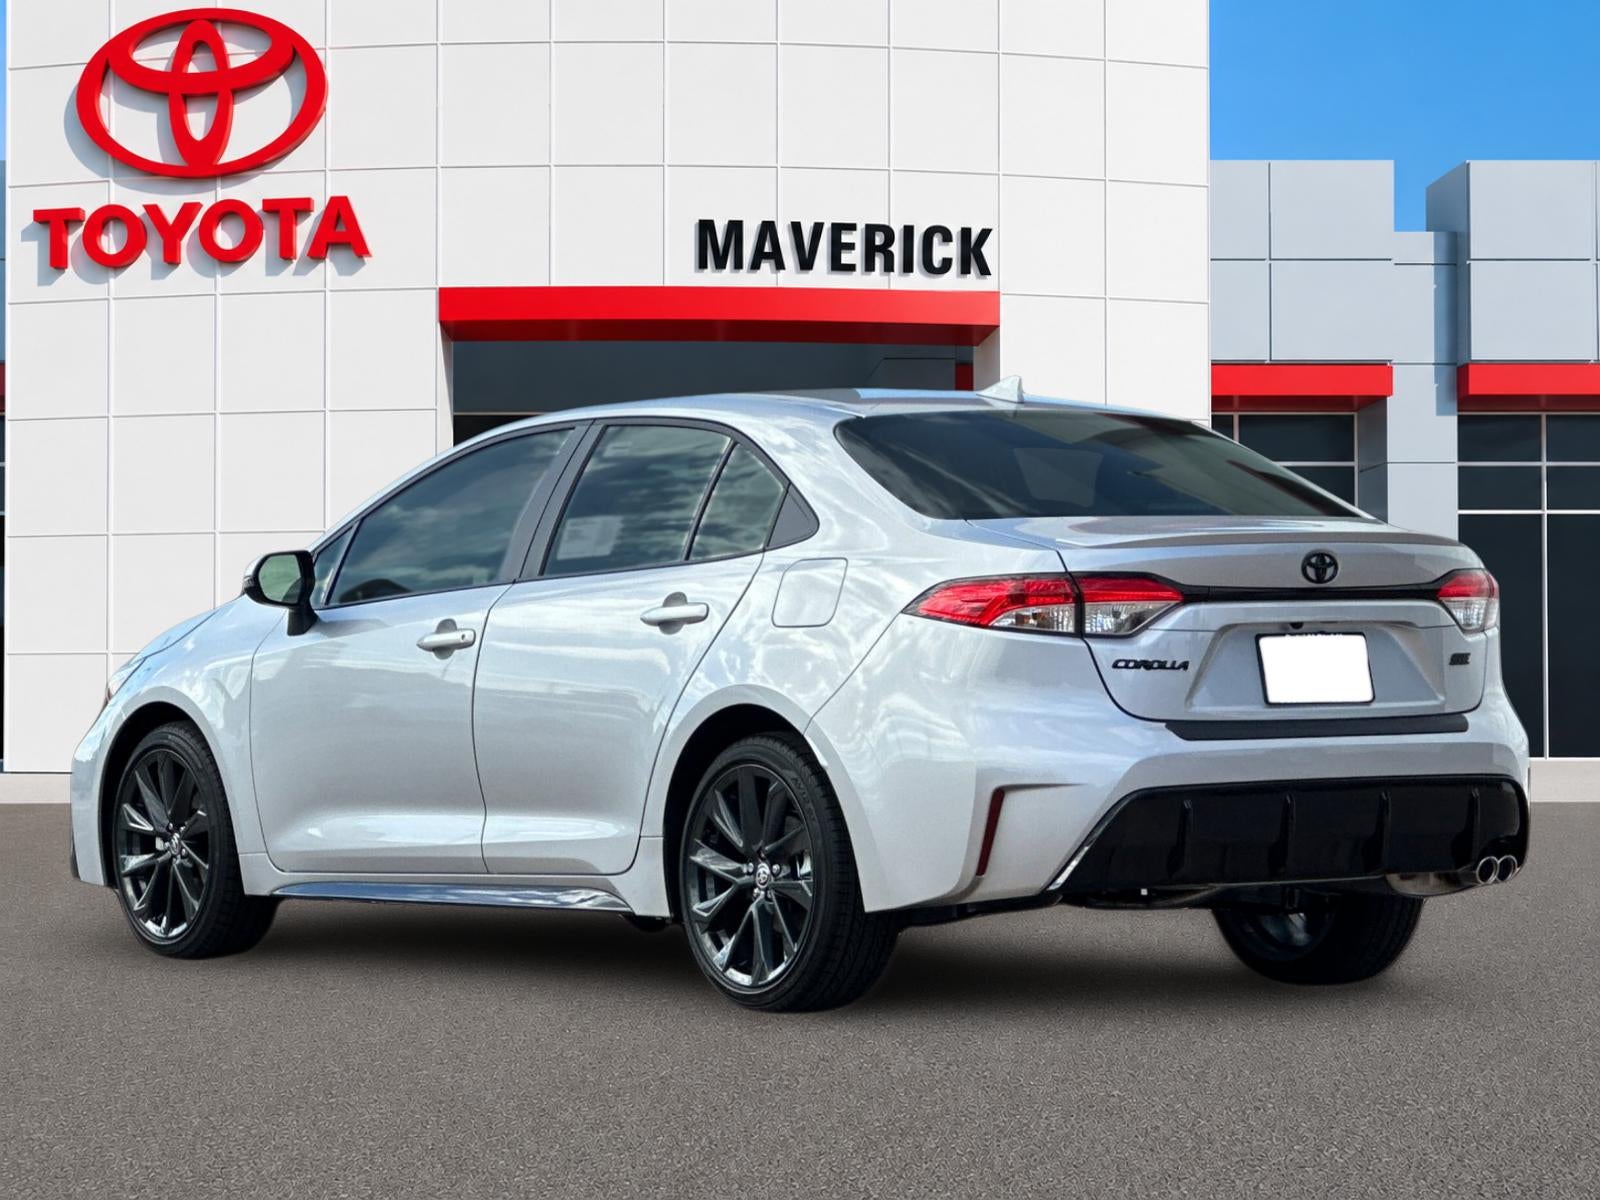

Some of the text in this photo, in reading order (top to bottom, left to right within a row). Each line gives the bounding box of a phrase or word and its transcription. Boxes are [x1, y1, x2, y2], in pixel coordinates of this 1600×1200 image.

[32, 195, 373, 270] TOYOTA
[697, 218, 993, 276] MAVERICK
[1111, 658, 1190, 671] COROLLA
